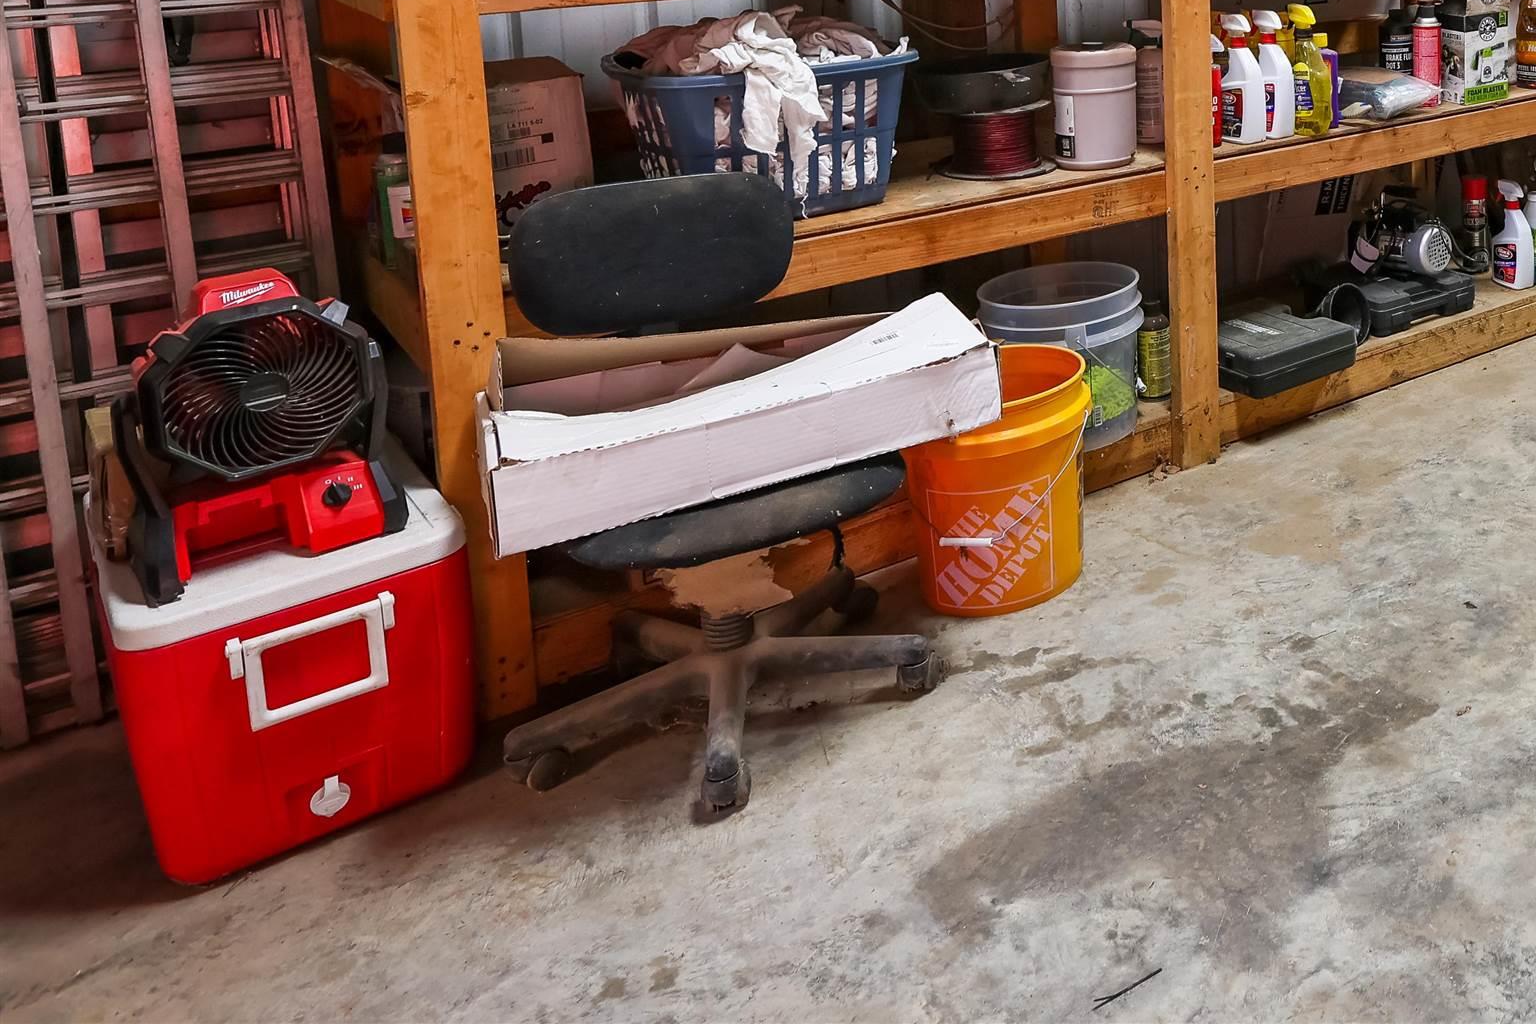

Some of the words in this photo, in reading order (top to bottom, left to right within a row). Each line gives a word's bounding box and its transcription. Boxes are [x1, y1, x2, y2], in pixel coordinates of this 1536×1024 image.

[1386, 53, 1402, 61] BRAKE
[1467, 88, 1482, 96] FOAM
[1483, 85, 1505, 94] BLASTER
[219, 282, 275, 304] Milwaukee
[936, 484, 1049, 607] HOME
[980, 522, 1051, 605] DEPOT
